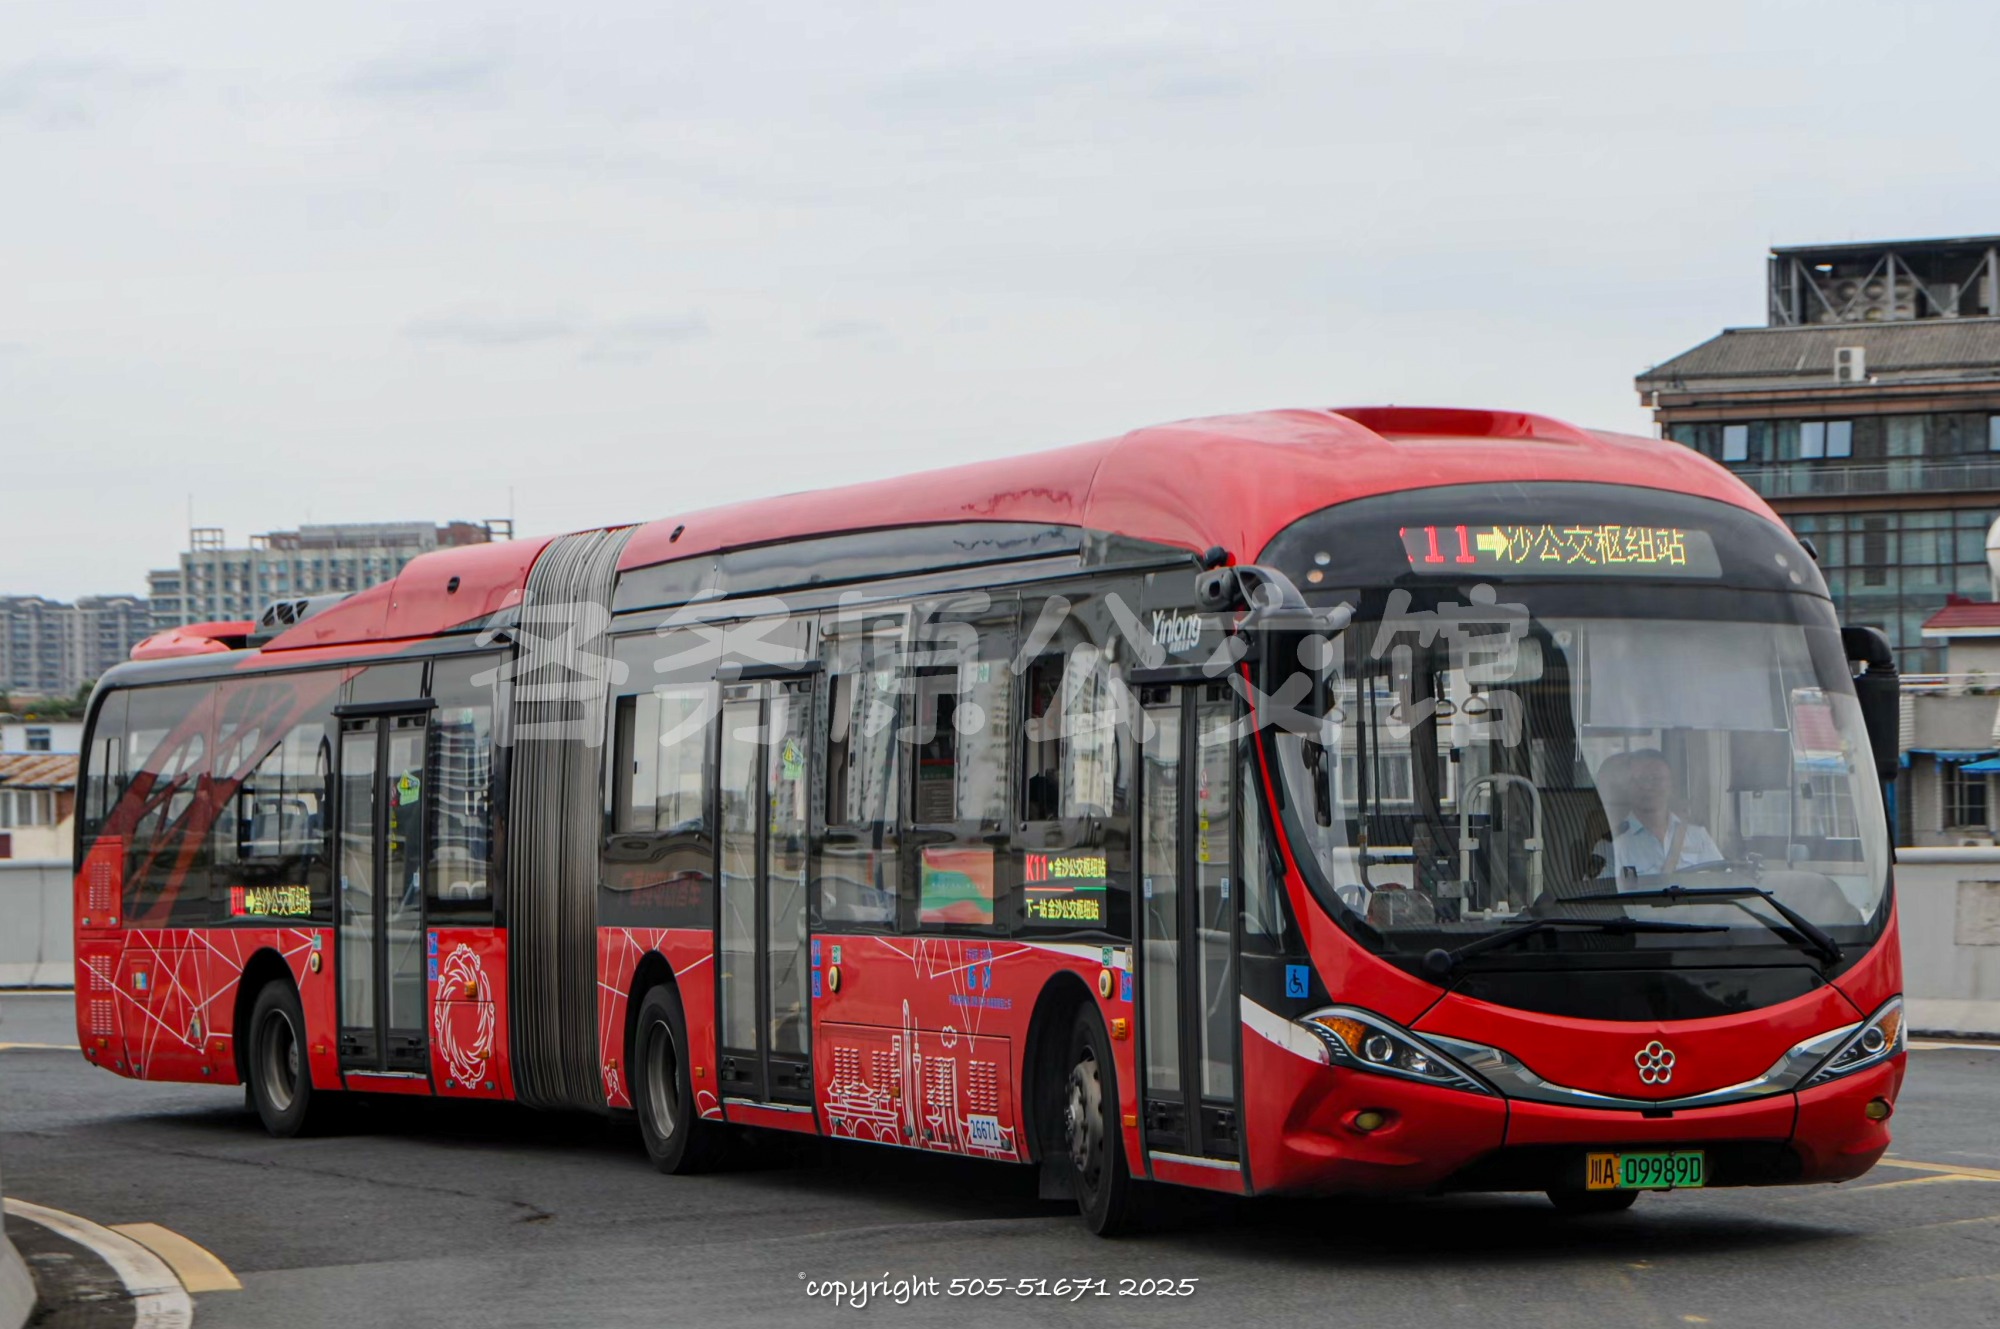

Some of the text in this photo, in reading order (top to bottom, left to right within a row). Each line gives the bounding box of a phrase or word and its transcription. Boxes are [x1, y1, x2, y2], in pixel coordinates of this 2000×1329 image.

[1399, 525, 1476, 563] 11
[1152, 608, 1201, 647] Yinlong
[1026, 854, 1106, 881] K11 金沙公交枢纽站
[970, 1119, 998, 1141] 26671
